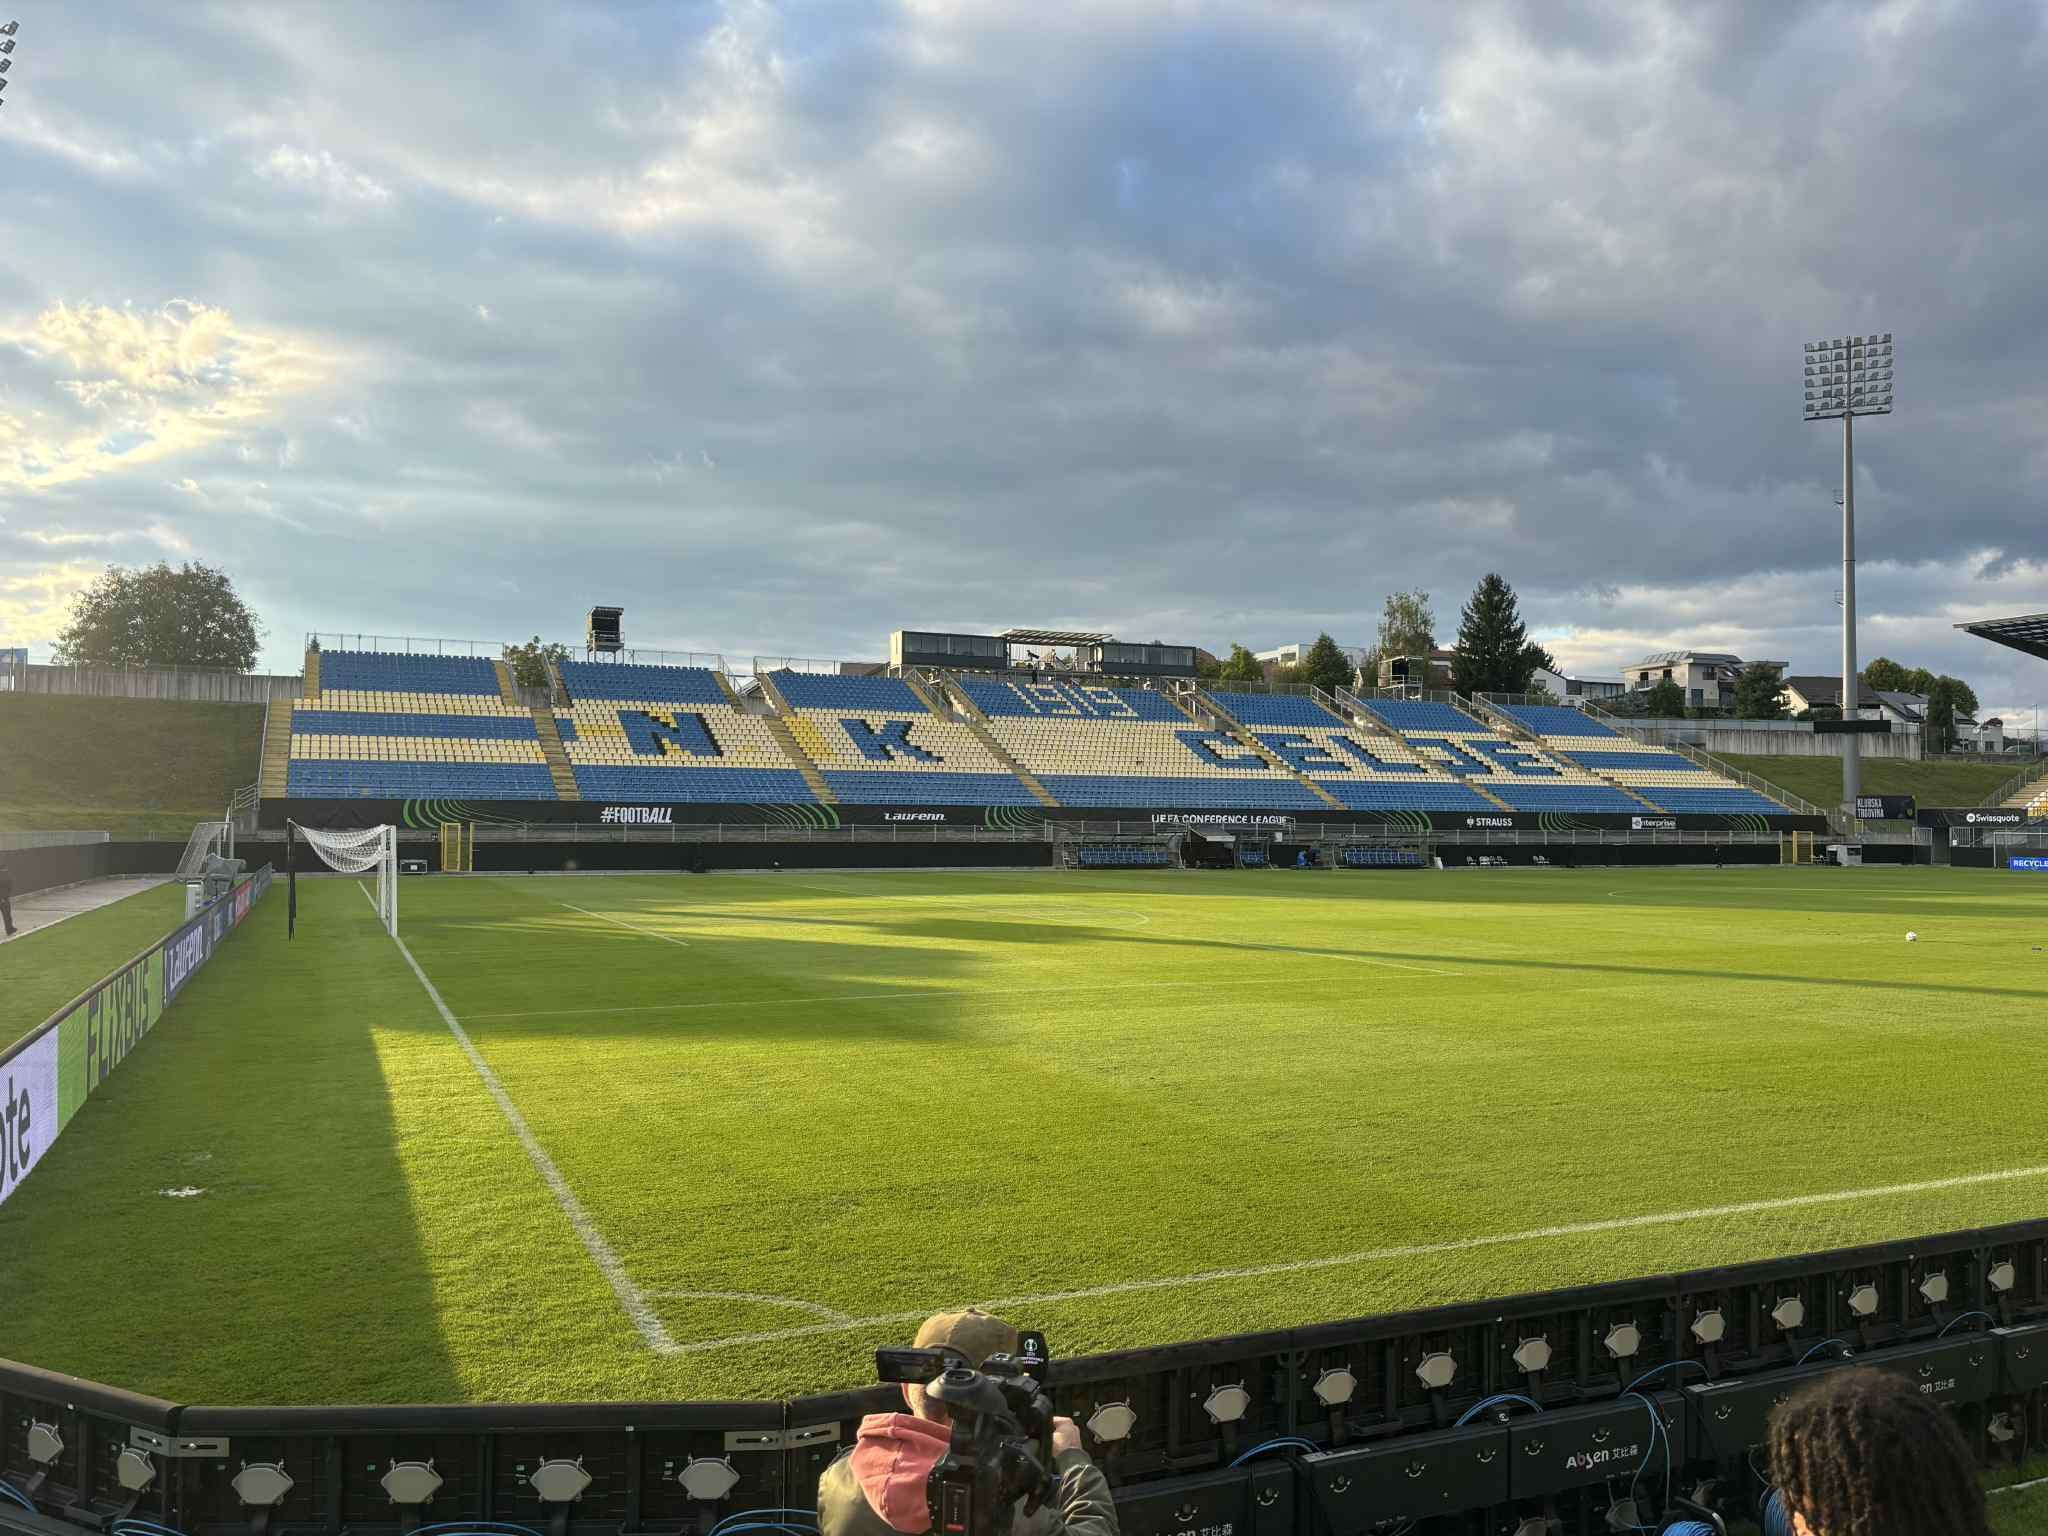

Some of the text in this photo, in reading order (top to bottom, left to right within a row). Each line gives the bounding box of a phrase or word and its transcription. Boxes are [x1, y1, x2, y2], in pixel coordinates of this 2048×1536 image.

[600, 806, 673, 823] #FOOTBALL
[1151, 814, 1288, 825] UEFA CONFERENCE LEAGUE
[1976, 814, 2020, 826] Swissquote
[1476, 817, 1513, 827] STRAUSS
[1566, 1450, 1610, 1470] Absen
